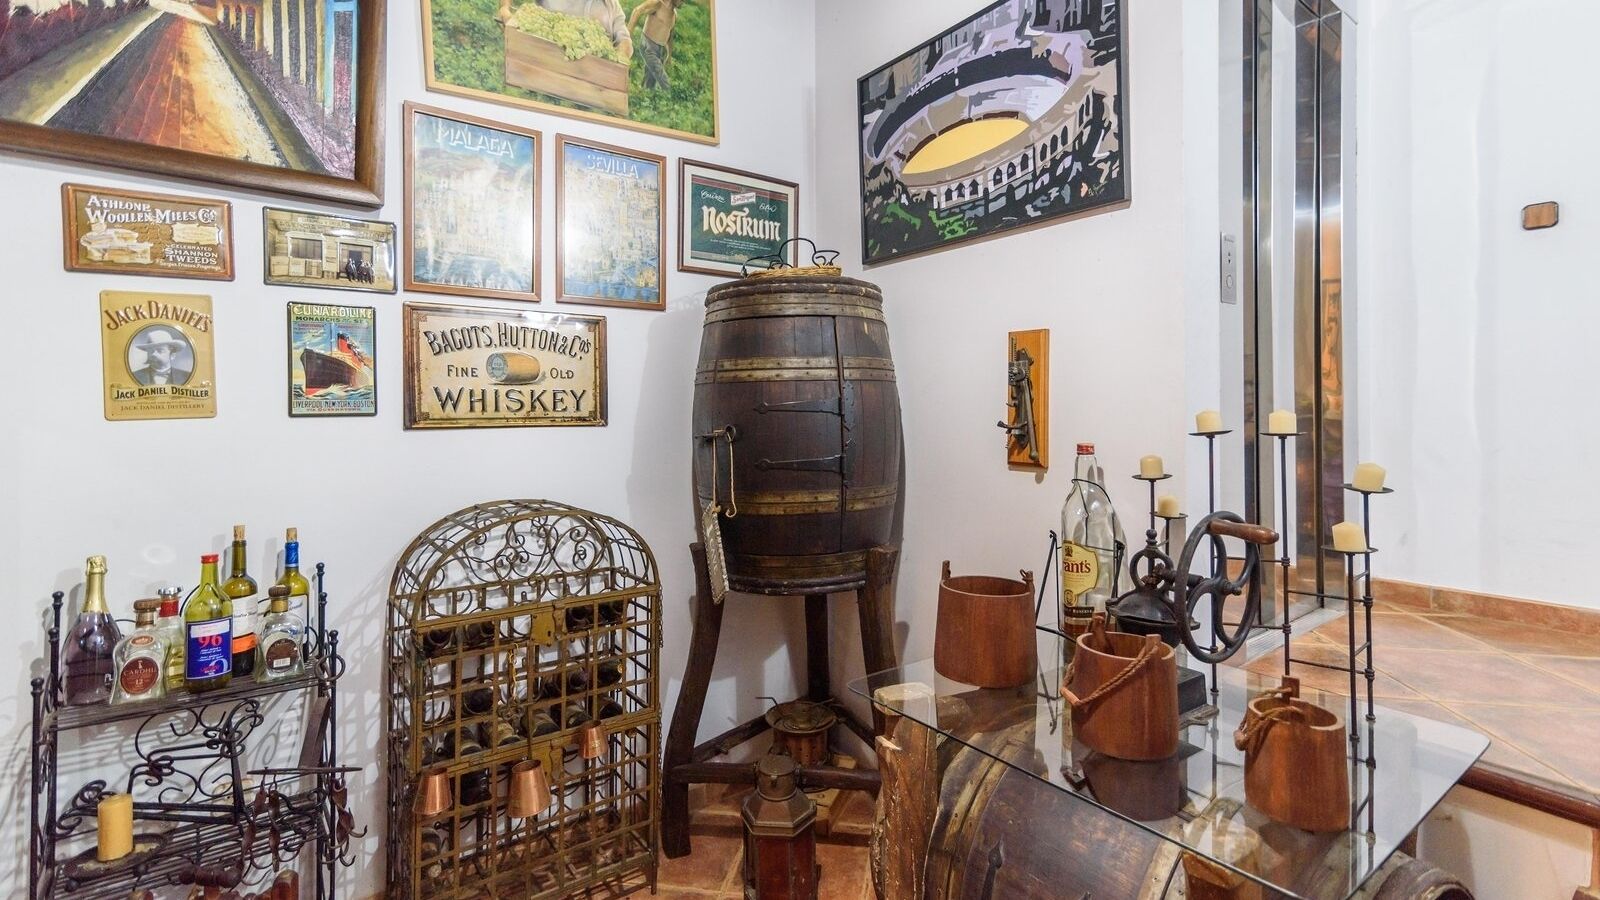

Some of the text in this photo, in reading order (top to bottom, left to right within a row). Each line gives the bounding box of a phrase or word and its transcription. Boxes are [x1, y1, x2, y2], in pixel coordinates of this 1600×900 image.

[585, 153, 639, 179] SEVILLA
[87, 194, 151, 212] ATHLONE
[84, 207, 153, 224] WOOLLEN
[154, 208, 197, 225] MILLS
[164, 247, 218, 258] SHANNON
[166, 254, 217, 265] TWEEDS
[104, 305, 148, 330] JACK
[447, 364, 479, 378] FINE
[549, 366, 575, 380] OLD
[115, 386, 209, 400] JACK DANIEL DISTILLER
[432, 385, 586, 413] WHISKEY
[292, 400, 324, 409] LIVERPOOL
